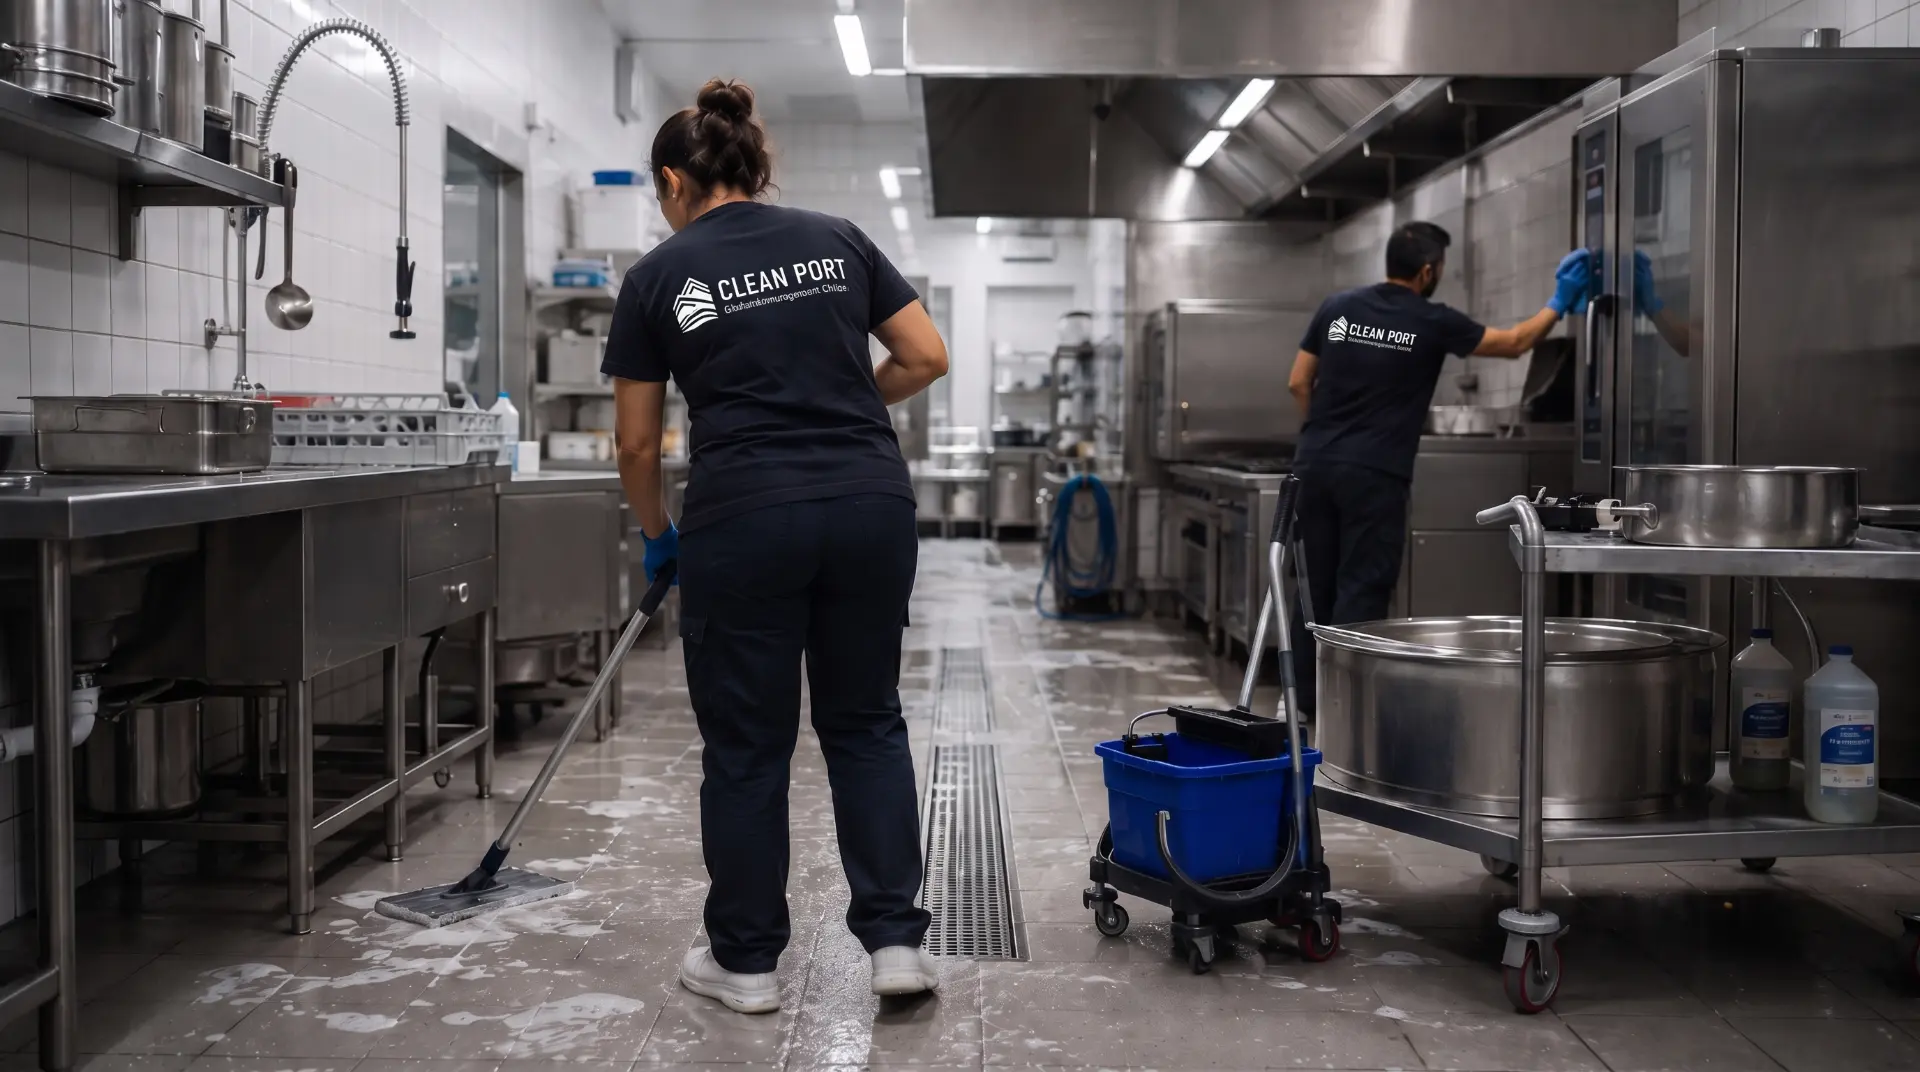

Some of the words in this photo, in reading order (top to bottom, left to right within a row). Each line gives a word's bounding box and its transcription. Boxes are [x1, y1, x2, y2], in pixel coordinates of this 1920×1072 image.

[717, 267, 788, 301] CLEAN
[792, 258, 846, 284] PORT
[1349, 323, 1385, 341] CLEAN
[1387, 330, 1417, 345] PORT
